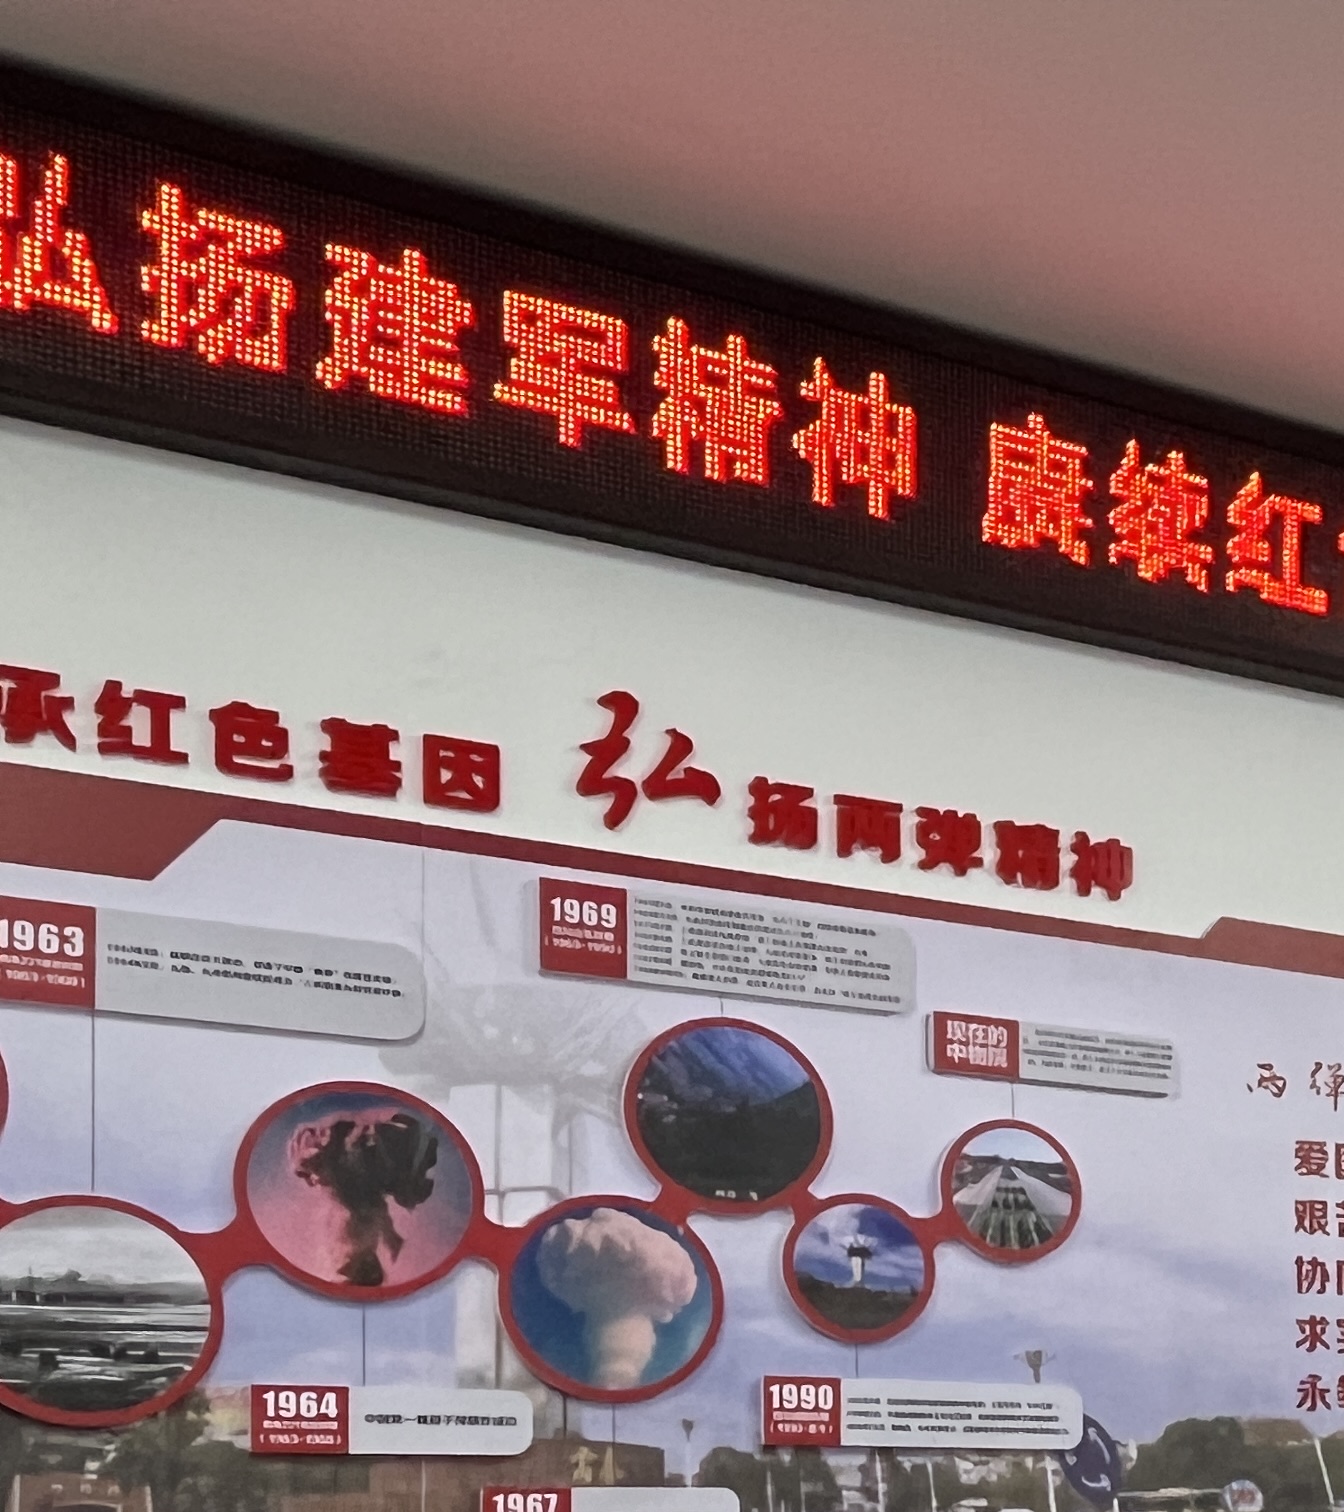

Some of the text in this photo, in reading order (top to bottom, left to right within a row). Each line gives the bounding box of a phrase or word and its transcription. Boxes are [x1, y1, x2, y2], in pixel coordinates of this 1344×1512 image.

[0, 150, 918, 521] 弘扬建军精神
[550, 896, 617, 929] 1969
[0, 918, 84, 957] 1963
[946, 1020, 1008, 1048] 现在的
[262, 1390, 338, 1419] 1964
[769, 1383, 834, 1410] 1990
